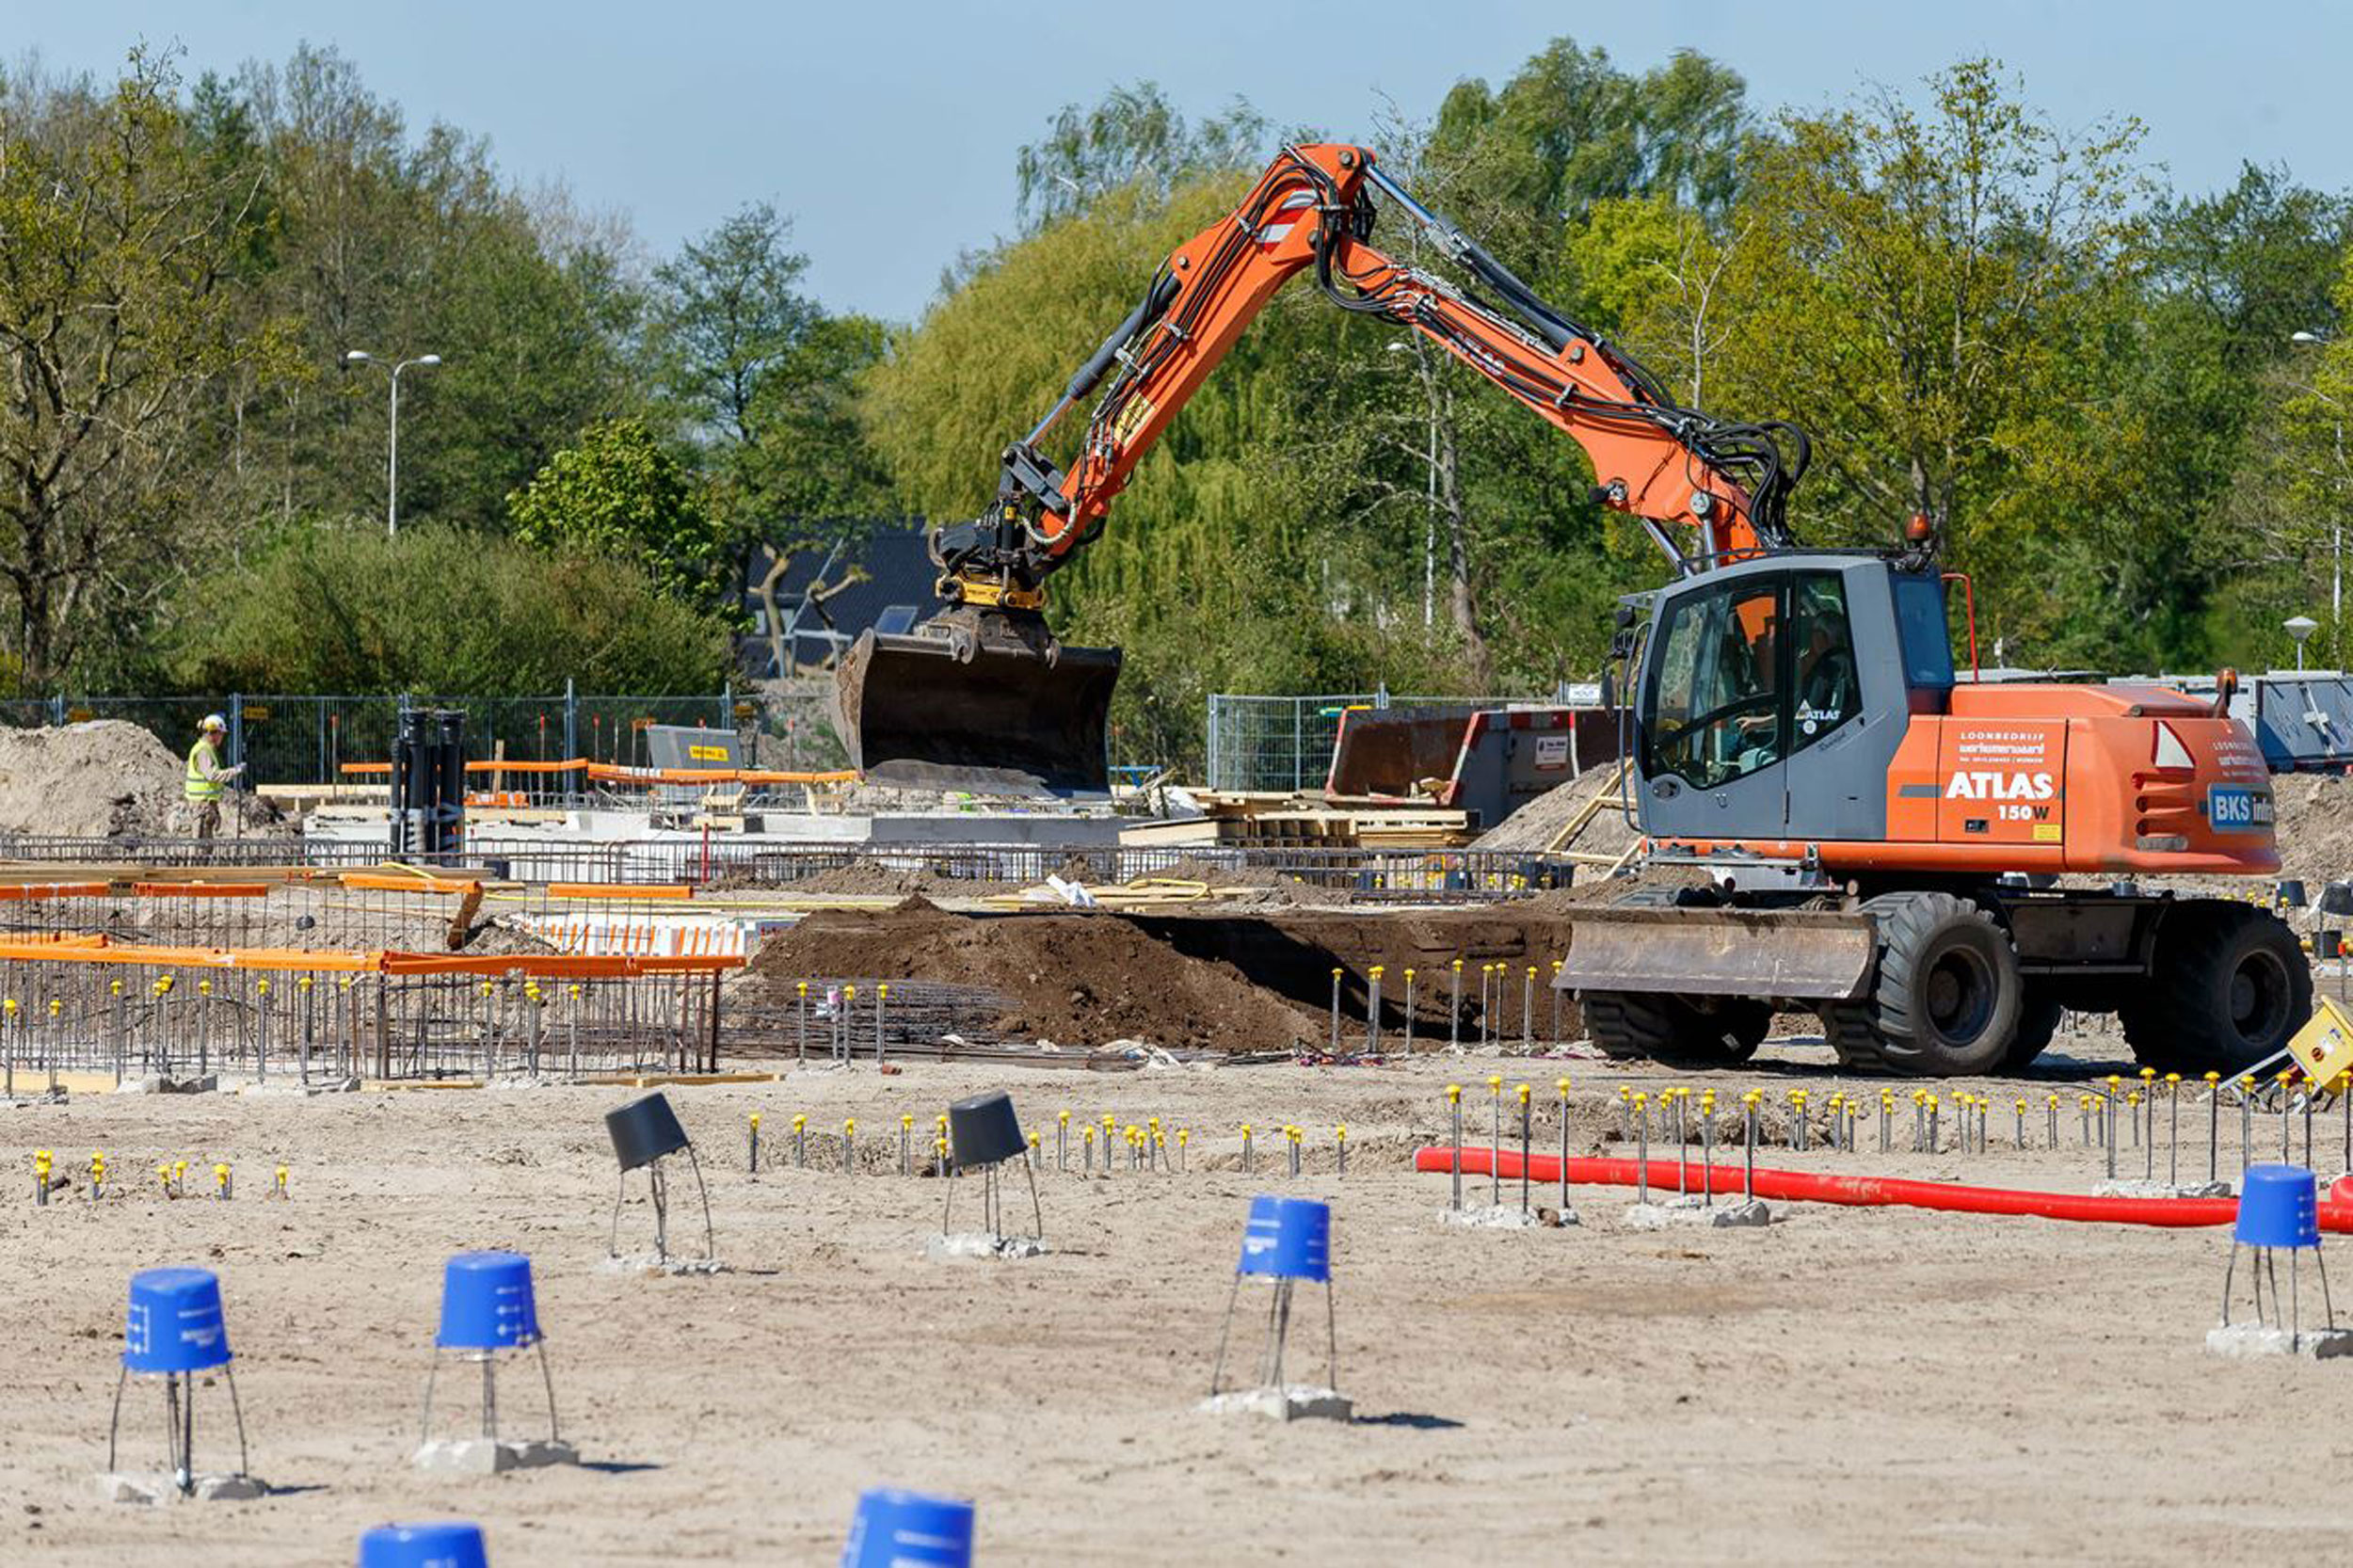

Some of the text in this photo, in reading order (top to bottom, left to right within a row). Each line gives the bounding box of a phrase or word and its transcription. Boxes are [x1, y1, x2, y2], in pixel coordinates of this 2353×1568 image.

[1805, 710, 1842, 720] ATLAS
[1945, 772, 2054, 799] ATLAS
[2215, 795, 2250, 821] BKS
